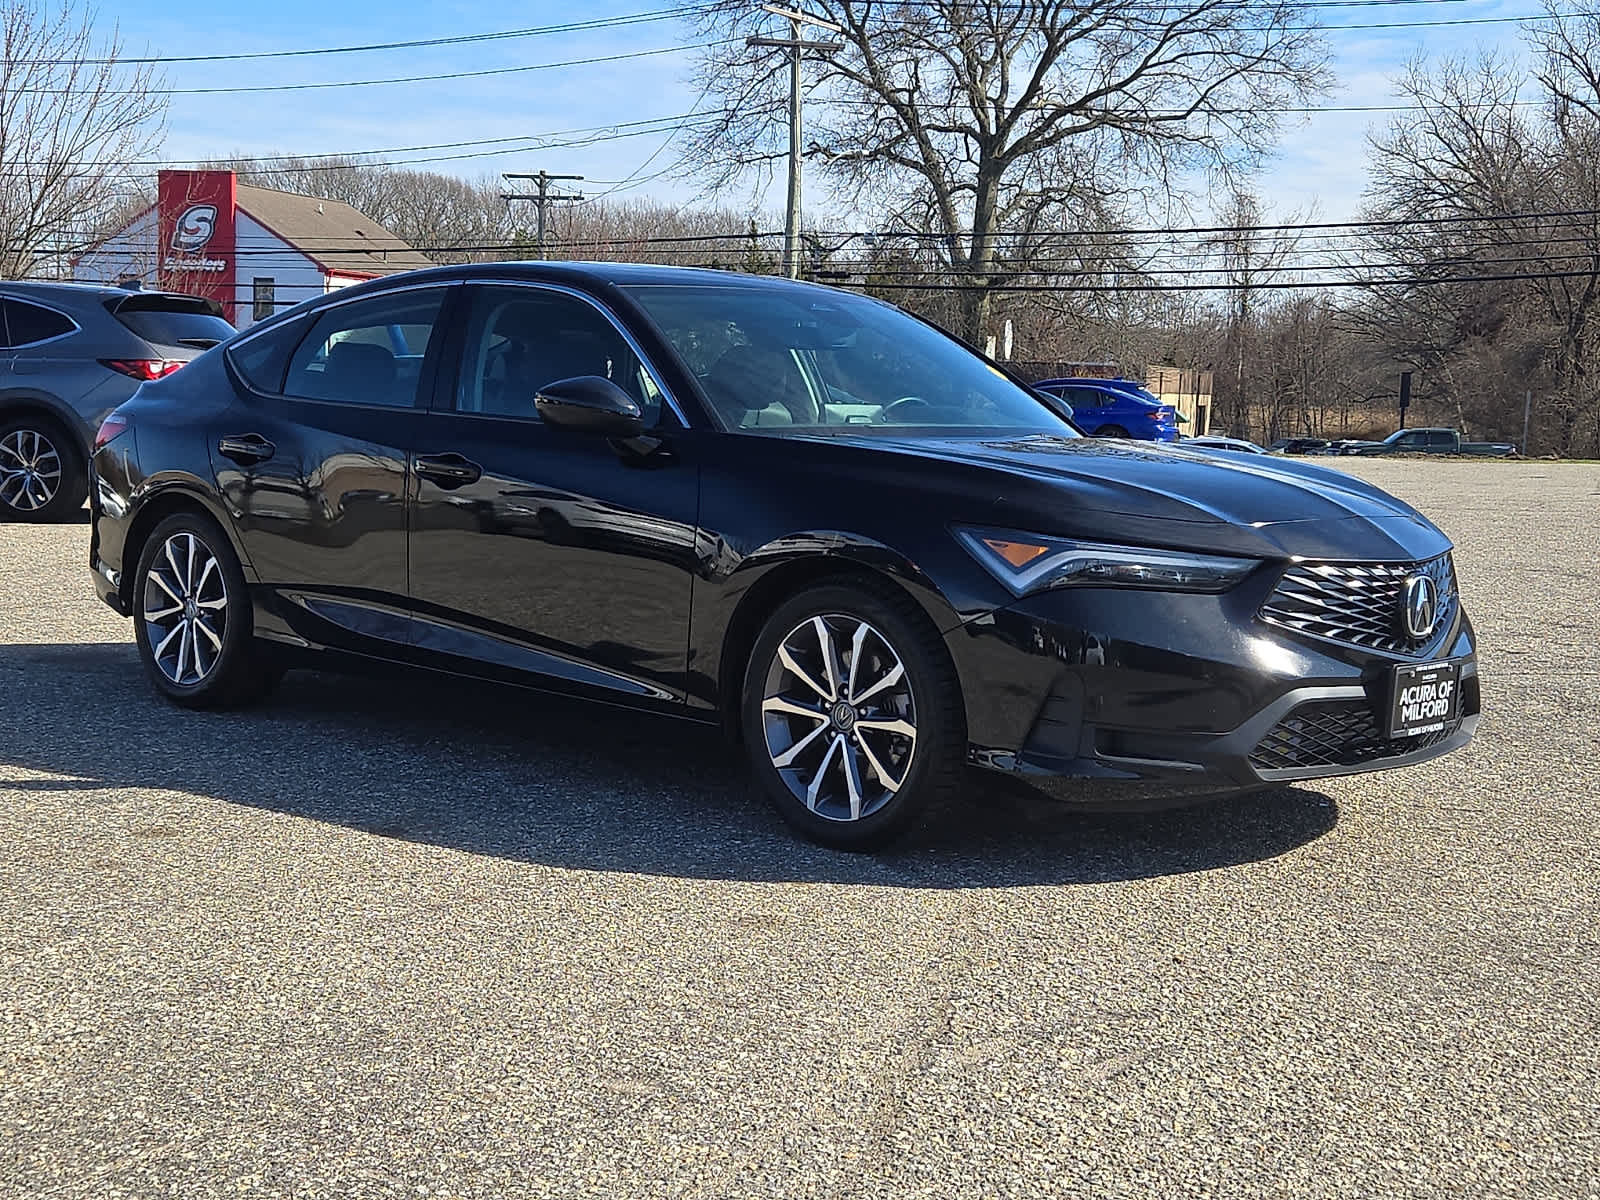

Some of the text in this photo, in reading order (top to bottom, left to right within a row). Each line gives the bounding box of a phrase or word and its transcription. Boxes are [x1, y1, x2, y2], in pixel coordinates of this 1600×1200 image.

[1400, 680, 1454, 705] ACURA OF
[1402, 699, 1449, 722] MILFORD
